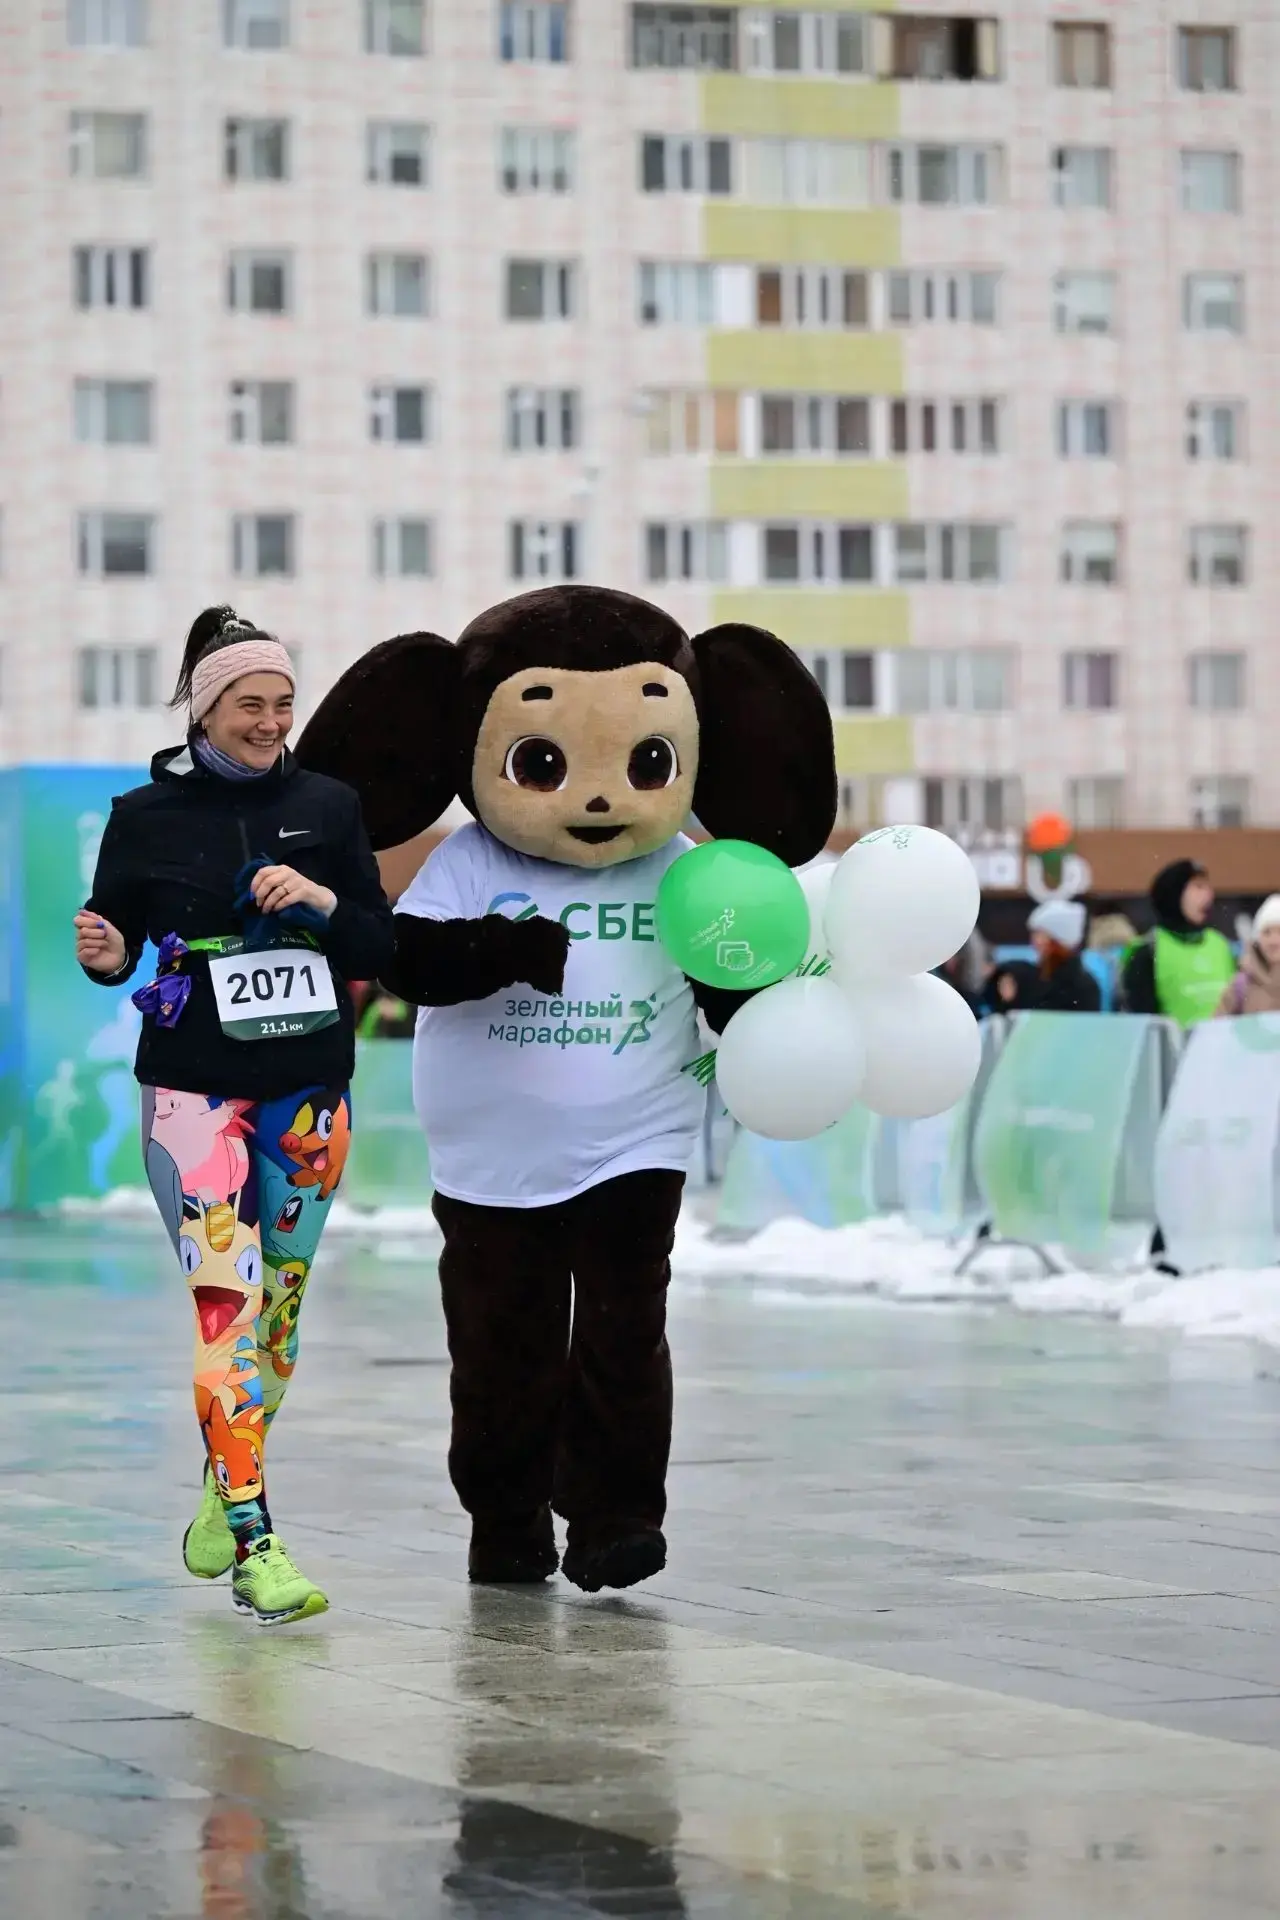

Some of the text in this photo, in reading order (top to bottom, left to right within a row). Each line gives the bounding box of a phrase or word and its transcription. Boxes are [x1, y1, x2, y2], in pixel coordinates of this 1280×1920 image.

[559, 902, 660, 941] СБЕ
[227, 965, 316, 1004] 2071
[504, 991, 623, 1018] зелёный
[260, 1021, 289, 1035] 21,1
[487, 1020, 611, 1049] марафон
